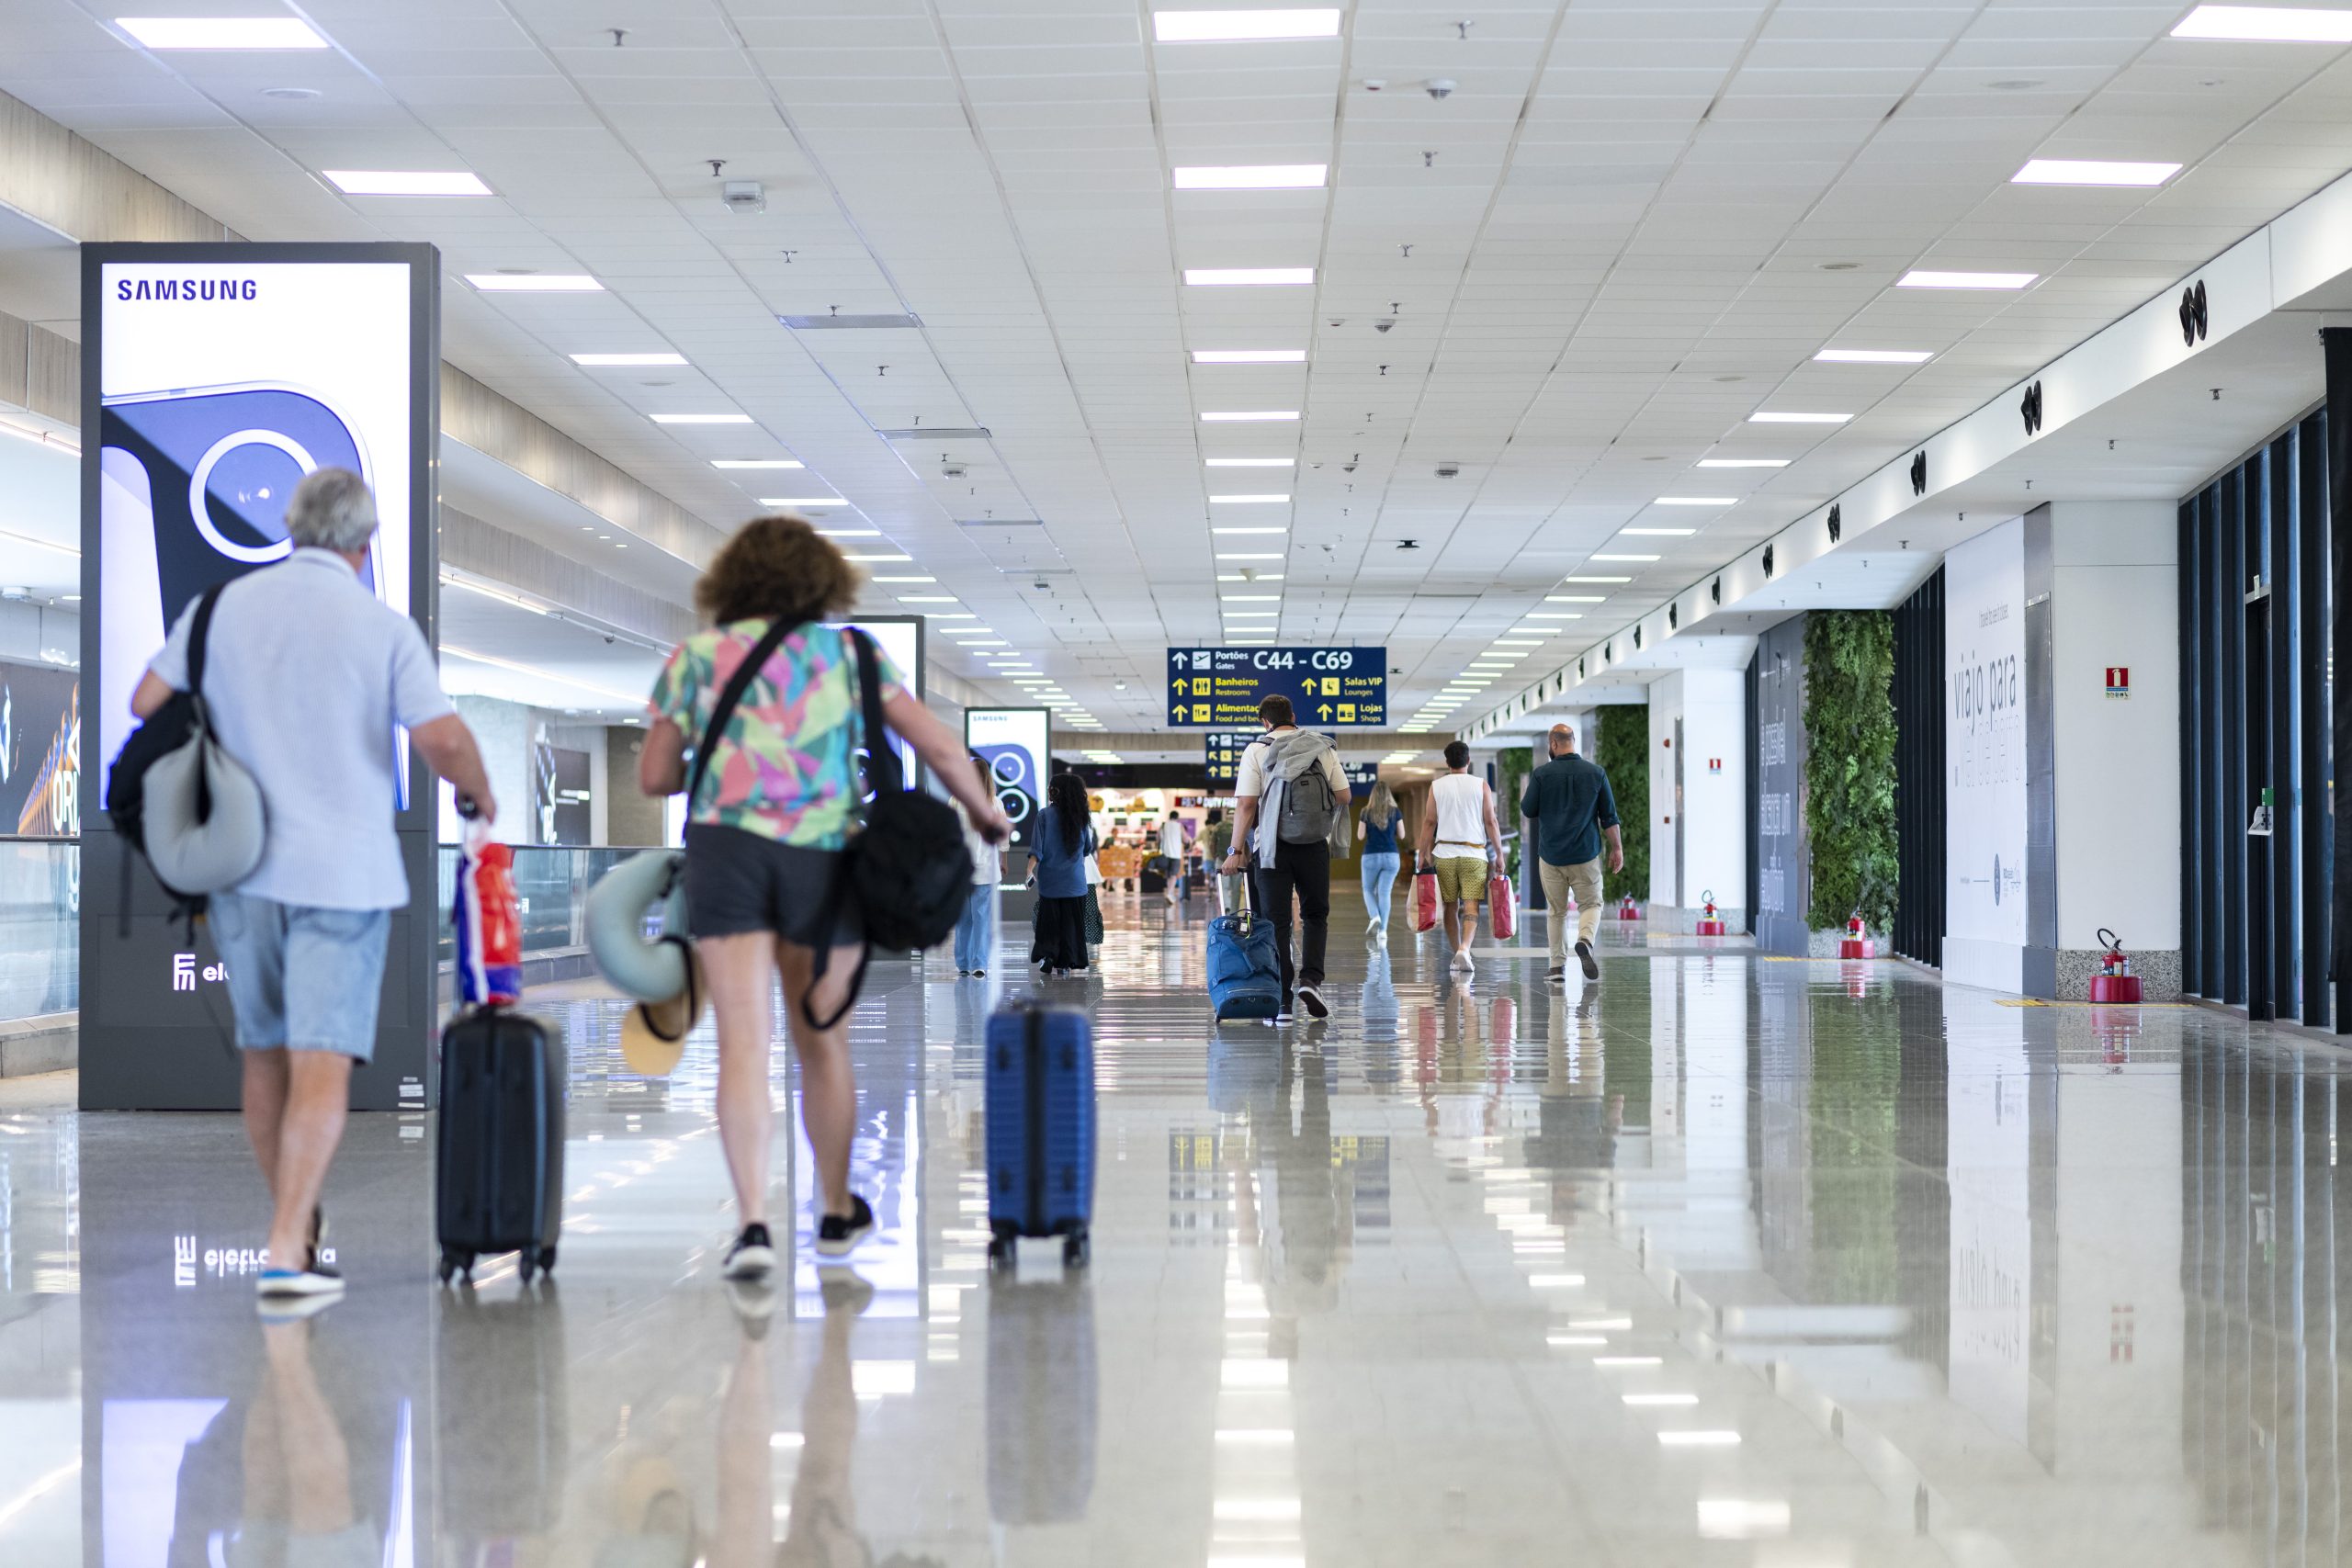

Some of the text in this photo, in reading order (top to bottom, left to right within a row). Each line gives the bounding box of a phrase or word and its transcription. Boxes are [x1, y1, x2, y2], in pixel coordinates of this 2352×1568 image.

[118, 279, 256, 300] SAMSUNG
[1216, 651, 1249, 660] Portões
[1253, 651, 1295, 670] C44
[1312, 651, 1353, 670] C69
[1216, 678, 1259, 686] Banheiros
[1344, 678, 1383, 686] Salas VIP
[1344, 689, 1373, 697] Lounges
[1954, 649, 2017, 736] viajo para
[1216, 704, 1260, 714] Alimentaç
[1361, 704, 1383, 714] Lojas
[1361, 715, 1381, 723] Shops
